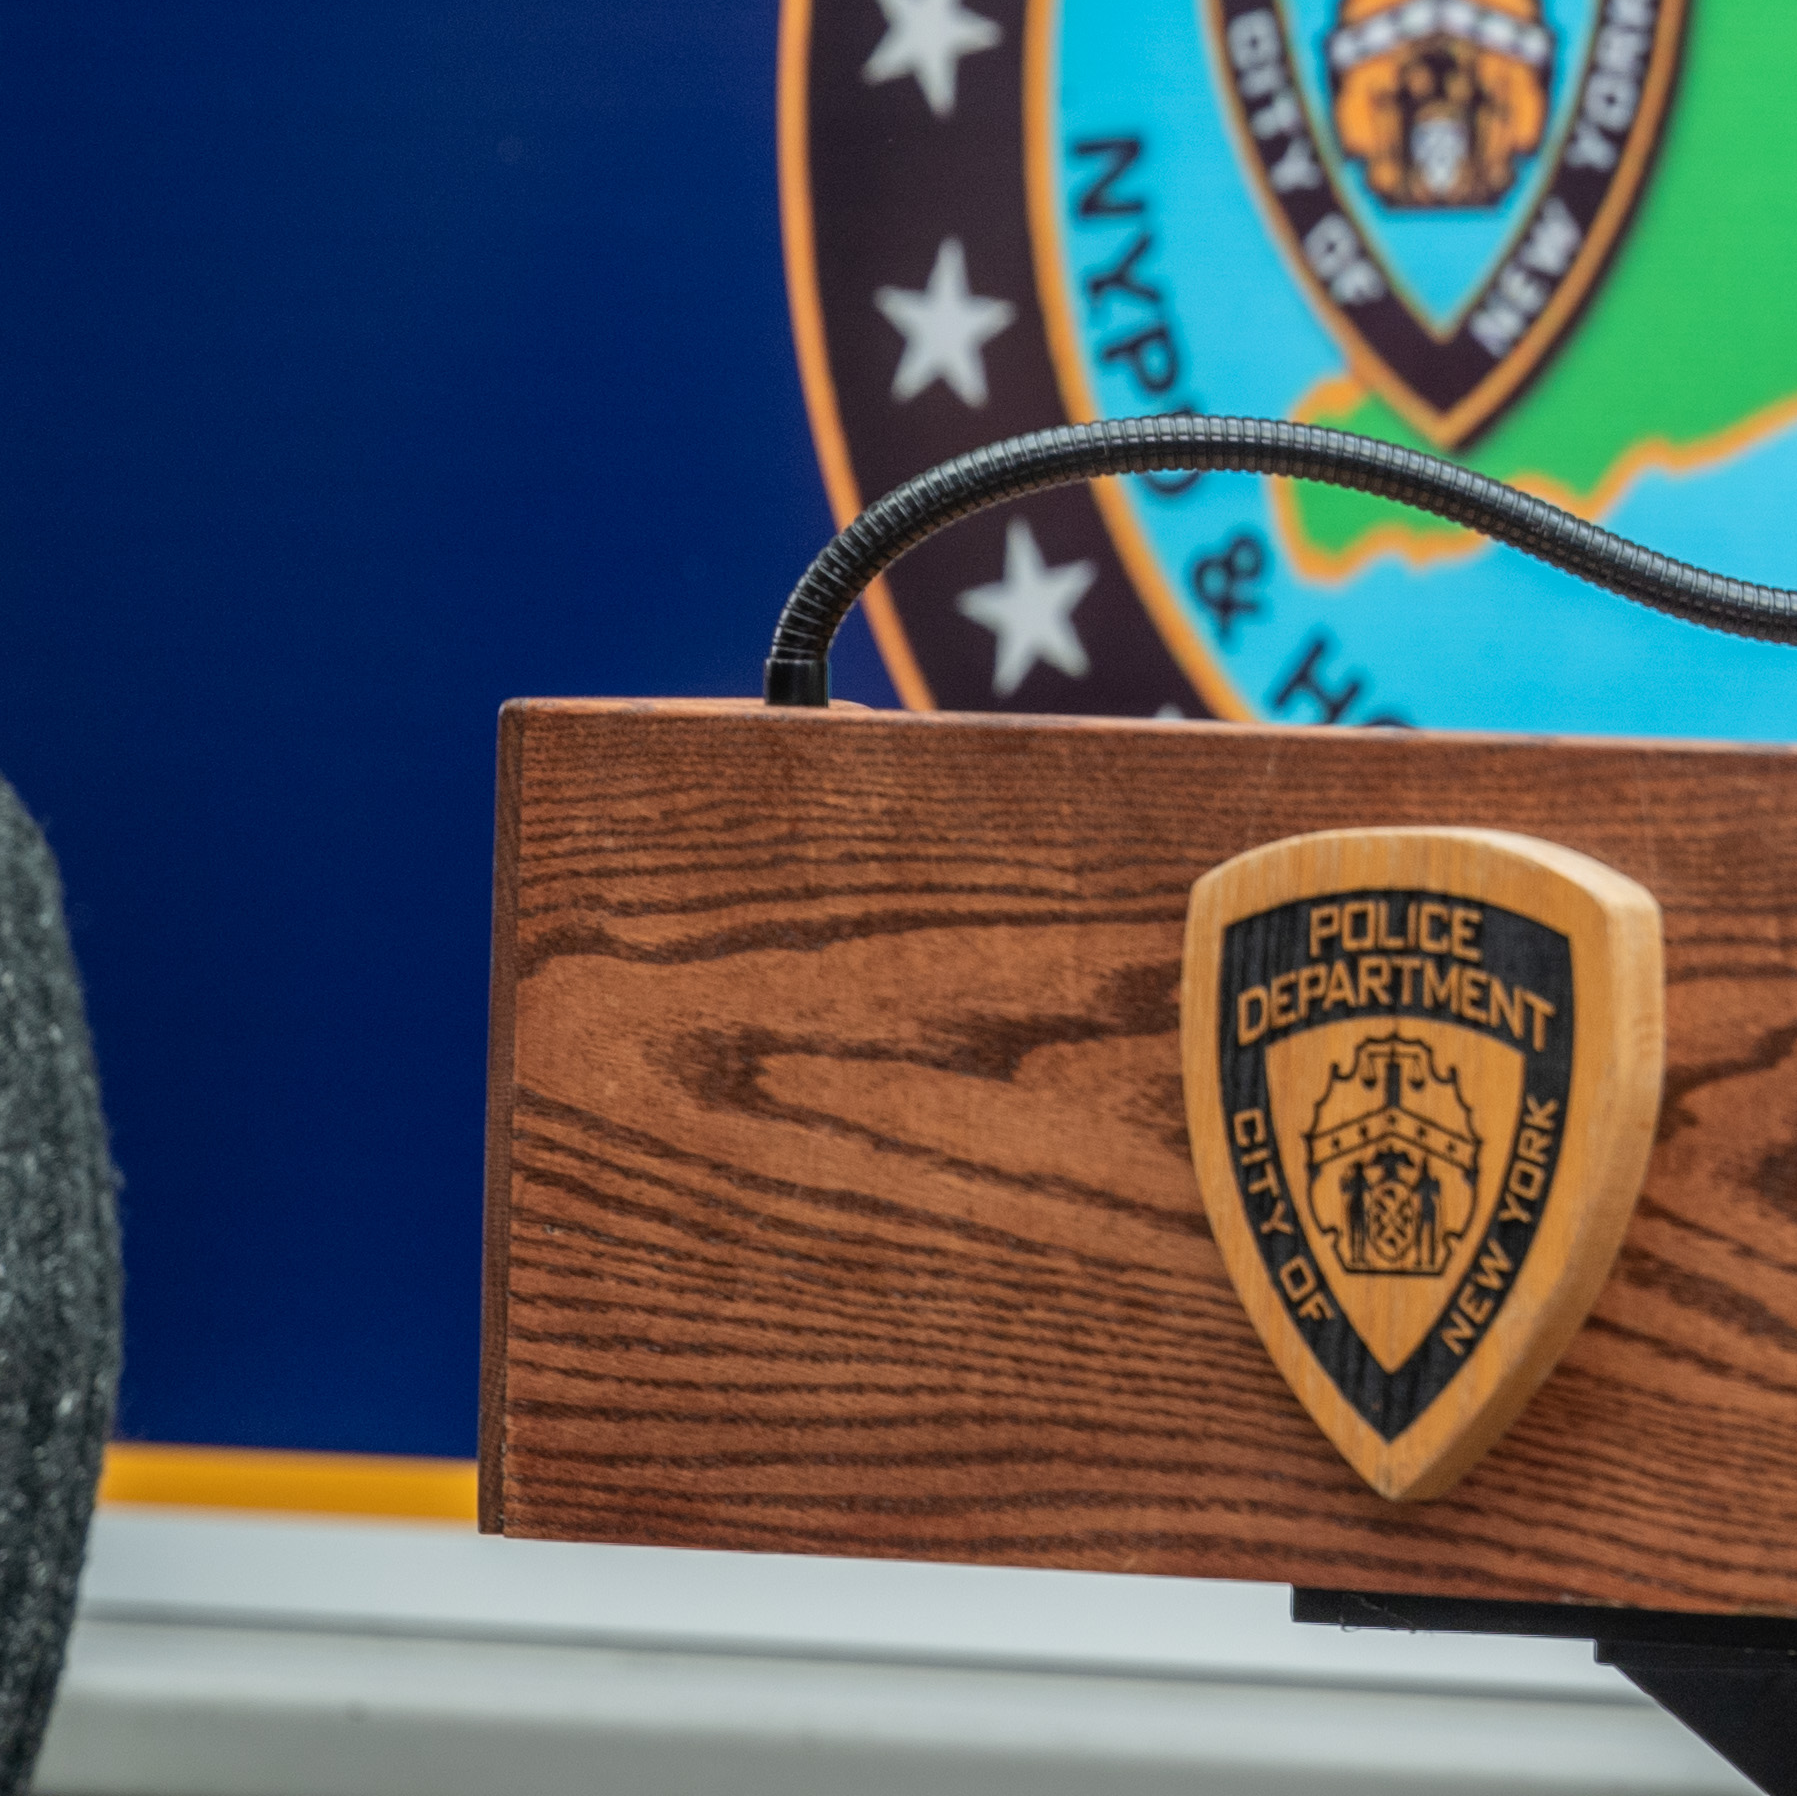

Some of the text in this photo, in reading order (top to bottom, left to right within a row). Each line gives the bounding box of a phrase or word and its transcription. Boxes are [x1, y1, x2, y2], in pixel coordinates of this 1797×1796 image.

[1226, 6, 1387, 309] CITY OF
[1469, 198, 1585, 359] NEW
[1188, 532, 1270, 638] &
[1236, 958, 1556, 1051] DEPARTMENT
[1308, 900, 1483, 962] POLICE
[1233, 1108, 1335, 1325] CITY OF
[1439, 1094, 1560, 1357] NEW YORK
